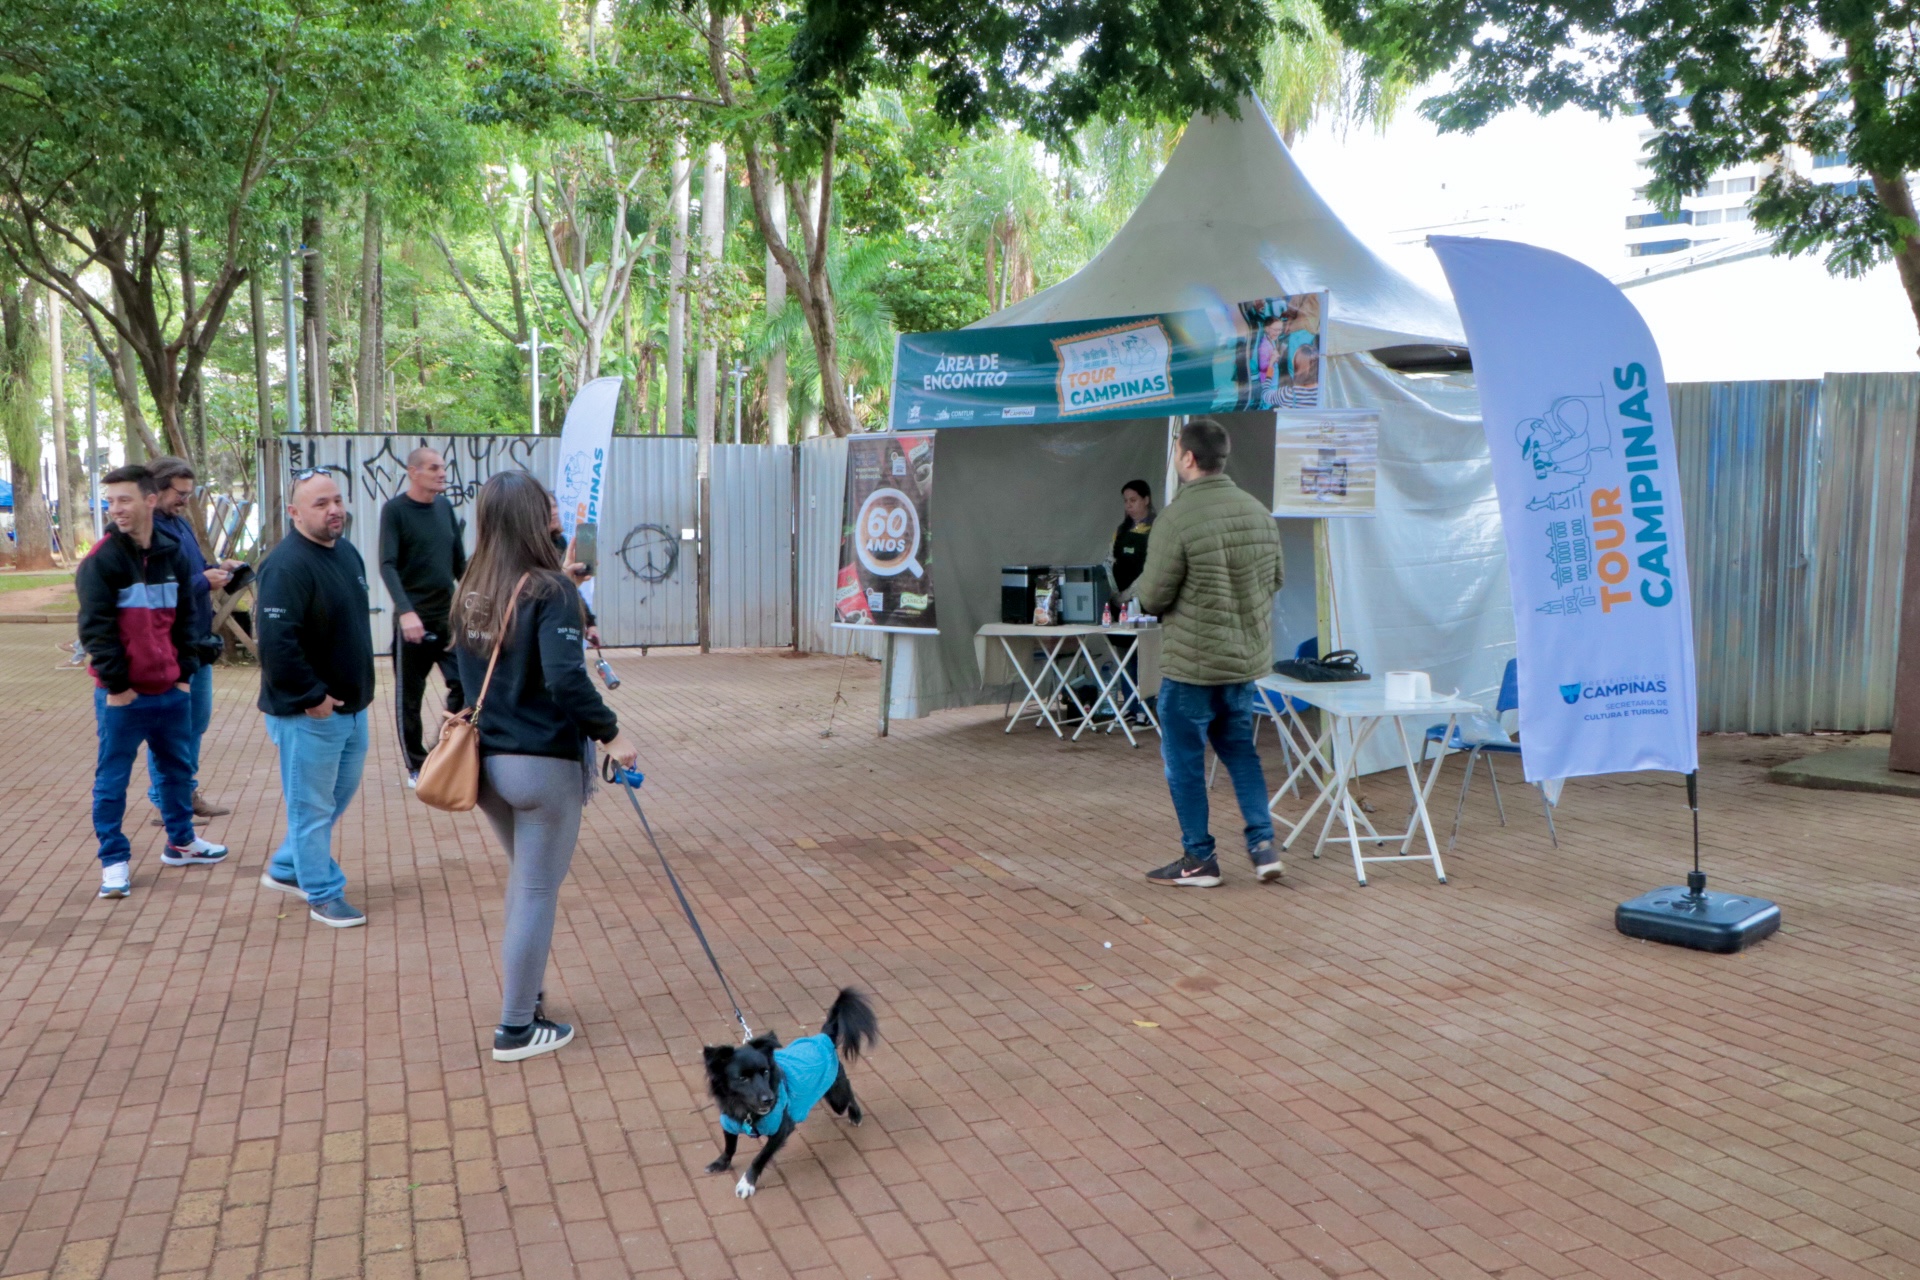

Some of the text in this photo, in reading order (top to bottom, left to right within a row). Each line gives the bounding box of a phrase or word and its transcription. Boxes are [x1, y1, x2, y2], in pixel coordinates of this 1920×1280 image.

[935, 352, 999, 372] ÁREA DE
[923, 371, 1008, 391] ENCONTRO
[1067, 367, 1116, 388] TOUR
[1070, 375, 1166, 406] CAMPINAS
[1613, 361, 1673, 608] CAMPINAS
[867, 507, 908, 538] 60
[866, 538, 906, 552] ANOS
[1589, 486, 1632, 614] TOUR
[1583, 674, 1646, 685] PREFEITURA
[1583, 681, 1666, 699] CAMPINAS
[1605, 700, 1655, 710] SECRETARIA
[1584, 711, 1622, 720] CULTURA
